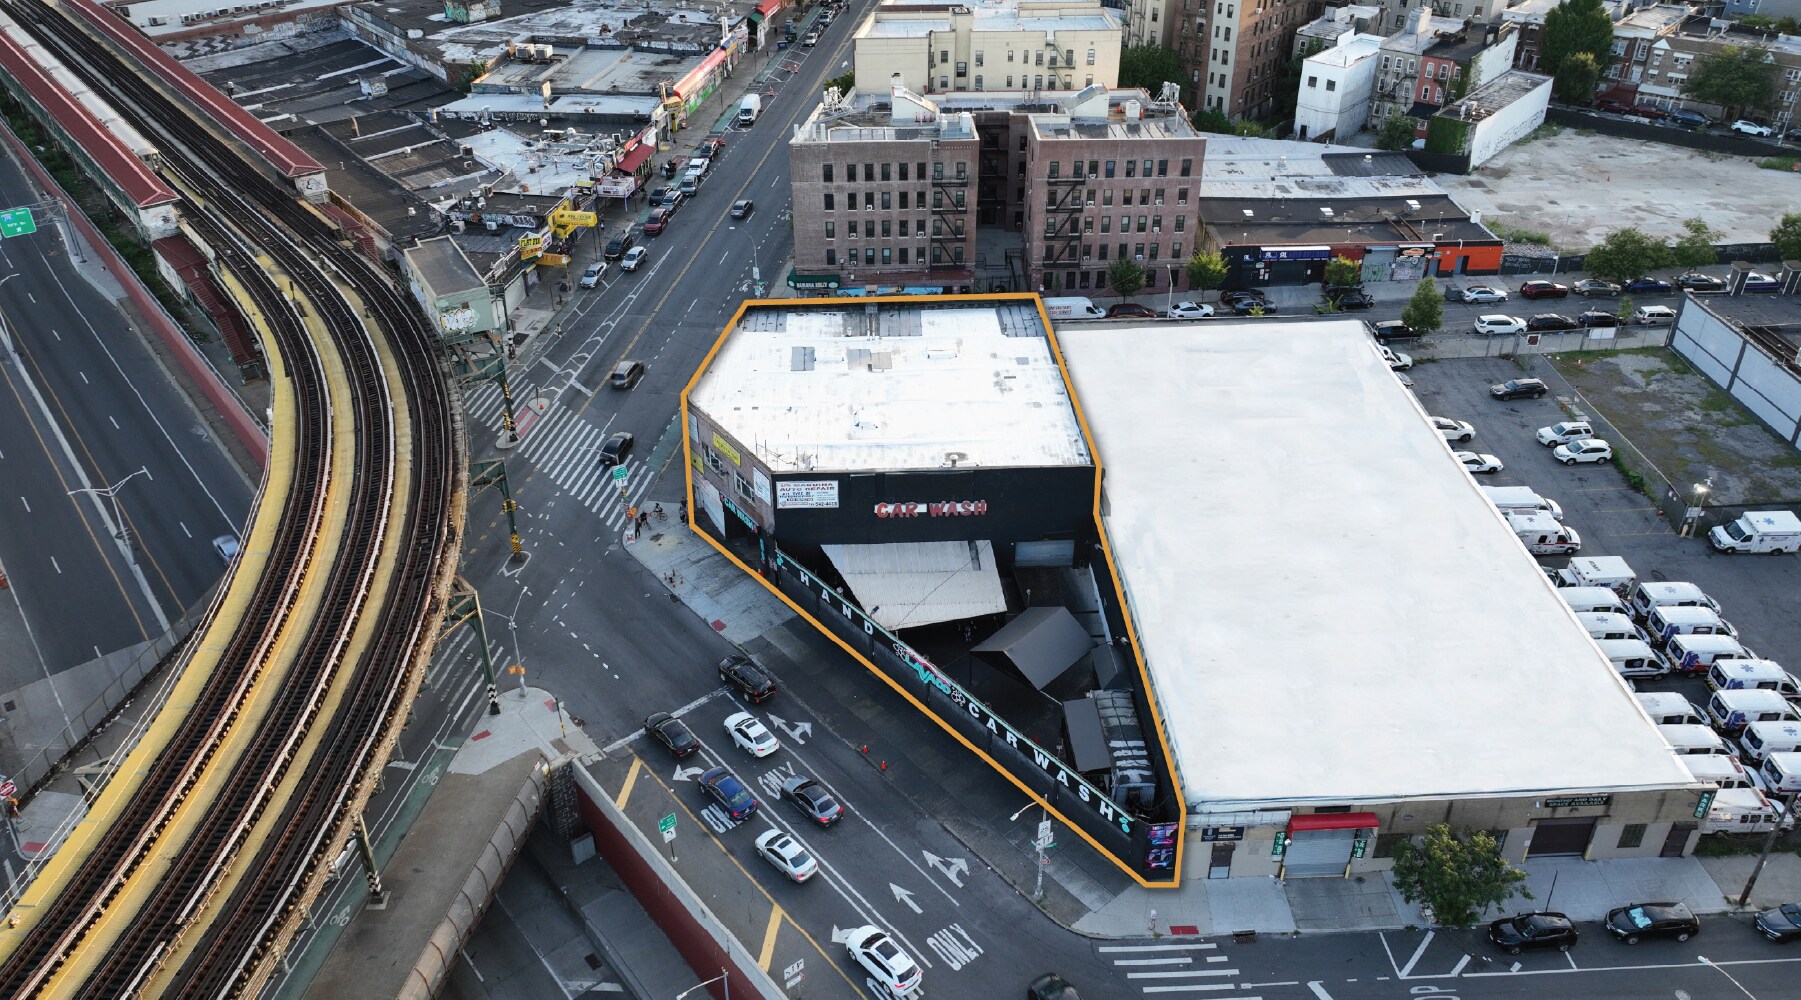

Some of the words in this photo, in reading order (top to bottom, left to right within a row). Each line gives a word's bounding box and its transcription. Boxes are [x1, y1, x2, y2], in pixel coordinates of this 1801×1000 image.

[876, 502, 919, 518] CAR
[928, 499, 986, 518] WASH
[800, 571, 874, 635] HAND
[905, 653, 951, 695] LAVADO
[968, 702, 1018, 749] CAR
[1033, 748, 1114, 822] WASH
[926, 923, 984, 971] ONLY
